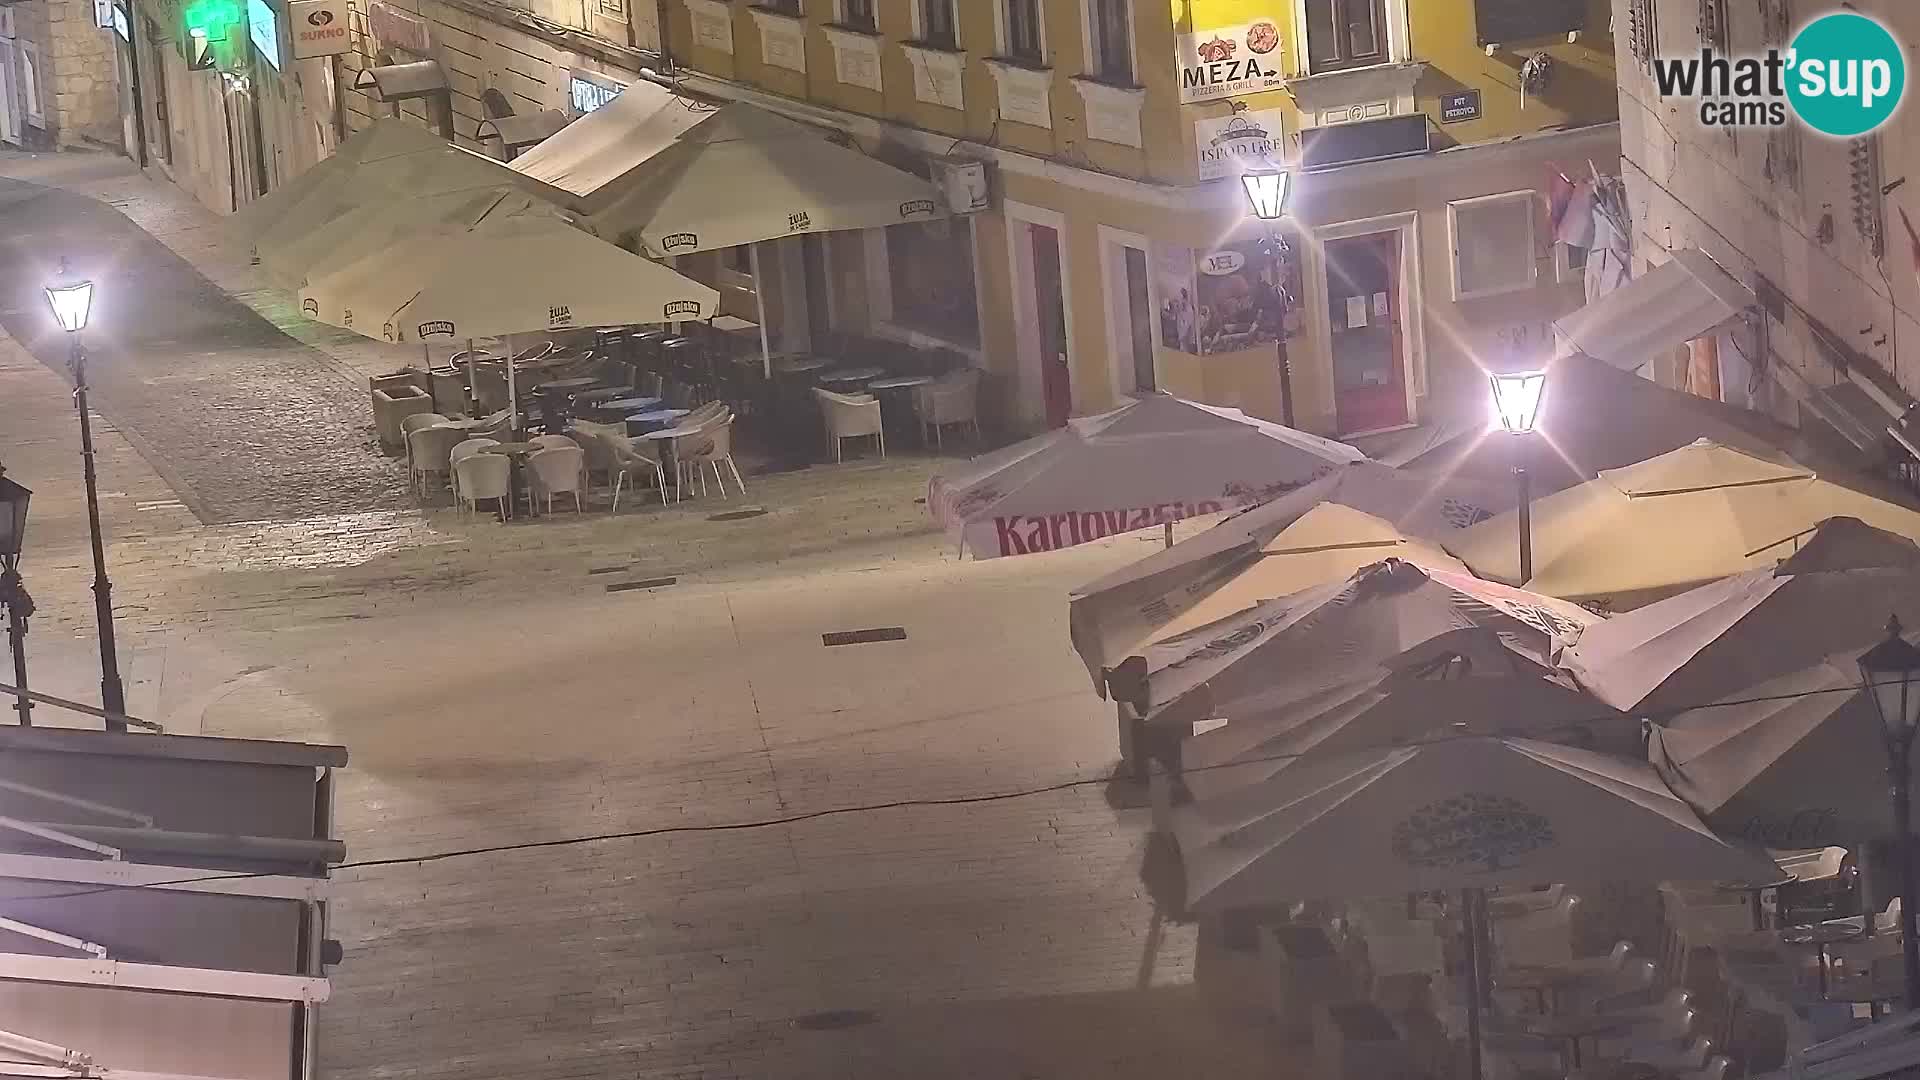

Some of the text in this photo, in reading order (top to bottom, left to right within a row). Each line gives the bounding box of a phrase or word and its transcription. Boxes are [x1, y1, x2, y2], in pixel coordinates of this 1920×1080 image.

[300, 28, 344, 41] SUKNO
[1183, 59, 1261, 88] MEZA
[1192, 85, 1226, 96] PIZZERIA
[1232, 81, 1255, 91] GRILL
[1201, 144, 1247, 161] ISPOD
